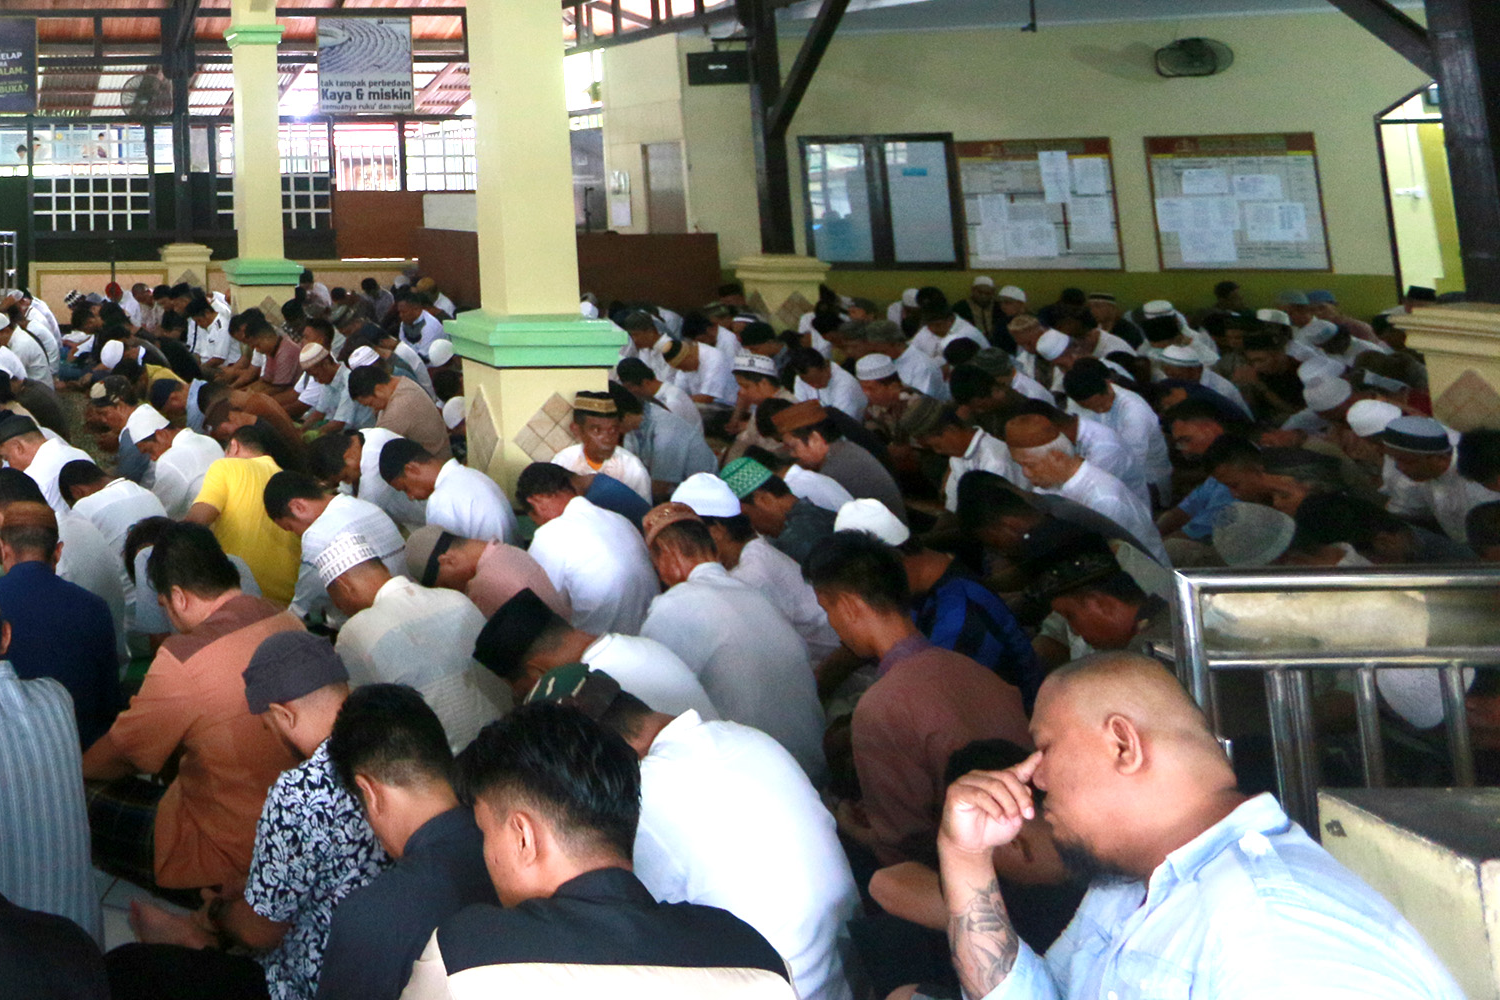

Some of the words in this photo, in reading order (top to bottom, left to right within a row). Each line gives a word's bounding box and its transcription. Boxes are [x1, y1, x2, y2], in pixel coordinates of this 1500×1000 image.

[320, 79, 334, 87] tak
[336, 79, 366, 88] tampak
[368, 79, 411, 88] perbedaan
[321, 88, 352, 104] Kaya
[368, 88, 411, 101] miskin
